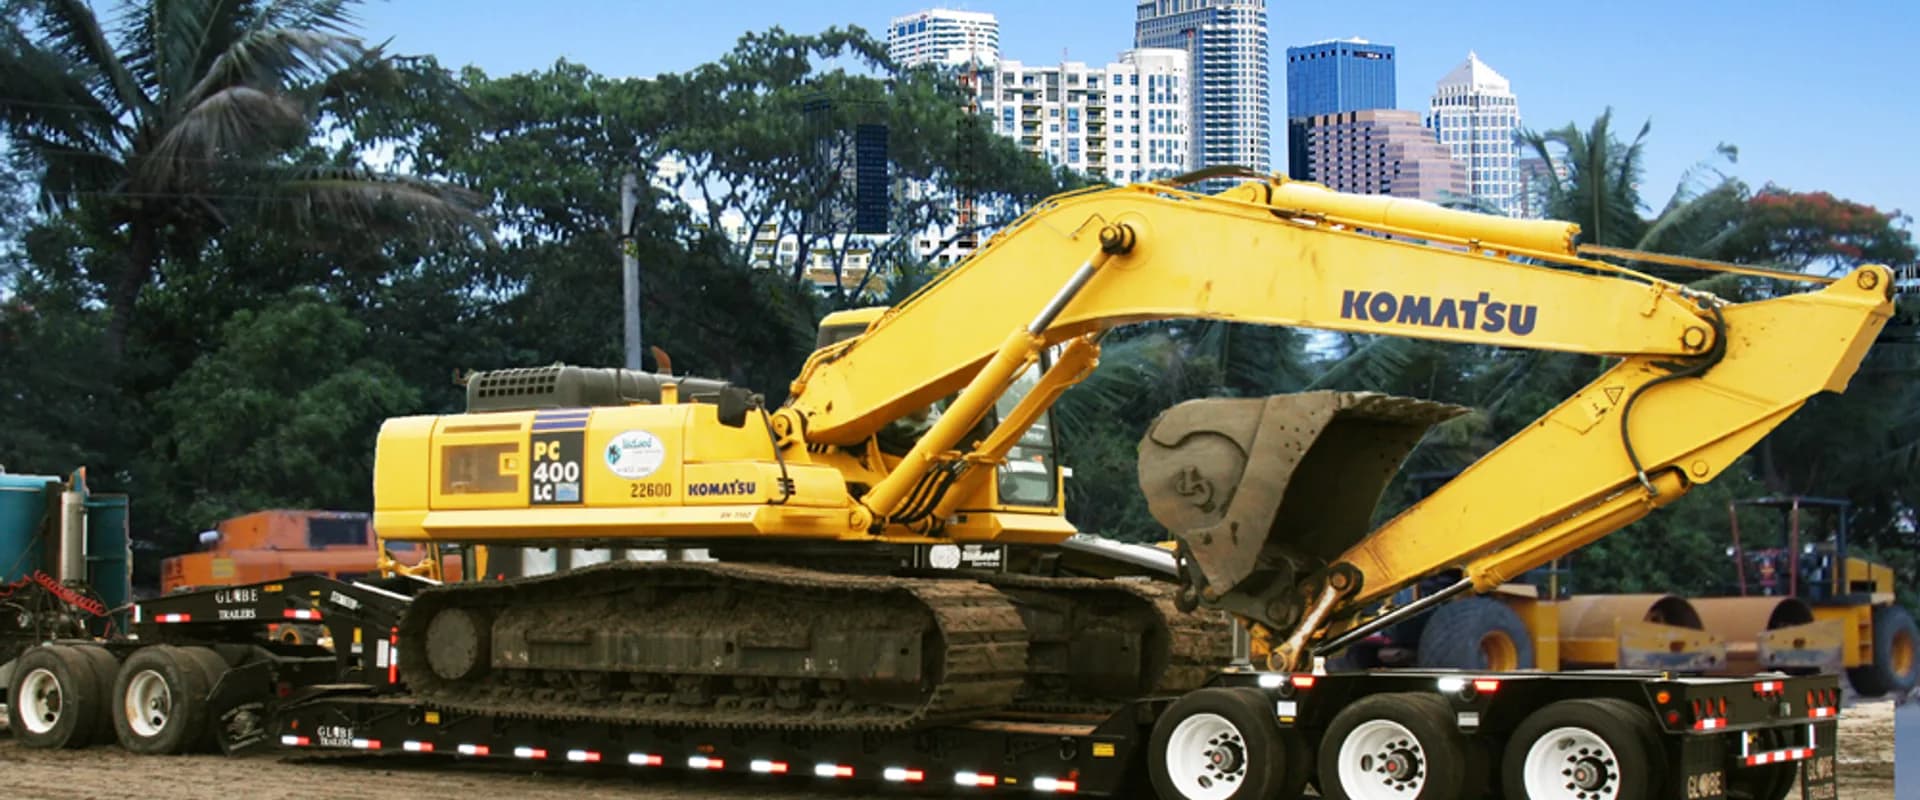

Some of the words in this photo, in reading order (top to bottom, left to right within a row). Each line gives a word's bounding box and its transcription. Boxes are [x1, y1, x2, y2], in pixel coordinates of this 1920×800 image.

[1341, 290, 1538, 336] KOMATSU
[533, 440, 560, 462] PC
[533, 461, 580, 483] 400
[533, 483, 552, 501] LC
[631, 483, 672, 498] 22600
[688, 479, 756, 496] KOMATSU
[215, 589, 258, 604] GLOBE
[218, 608, 257, 621] TRAILERS
[1687, 771, 1722, 799] GLOBE
